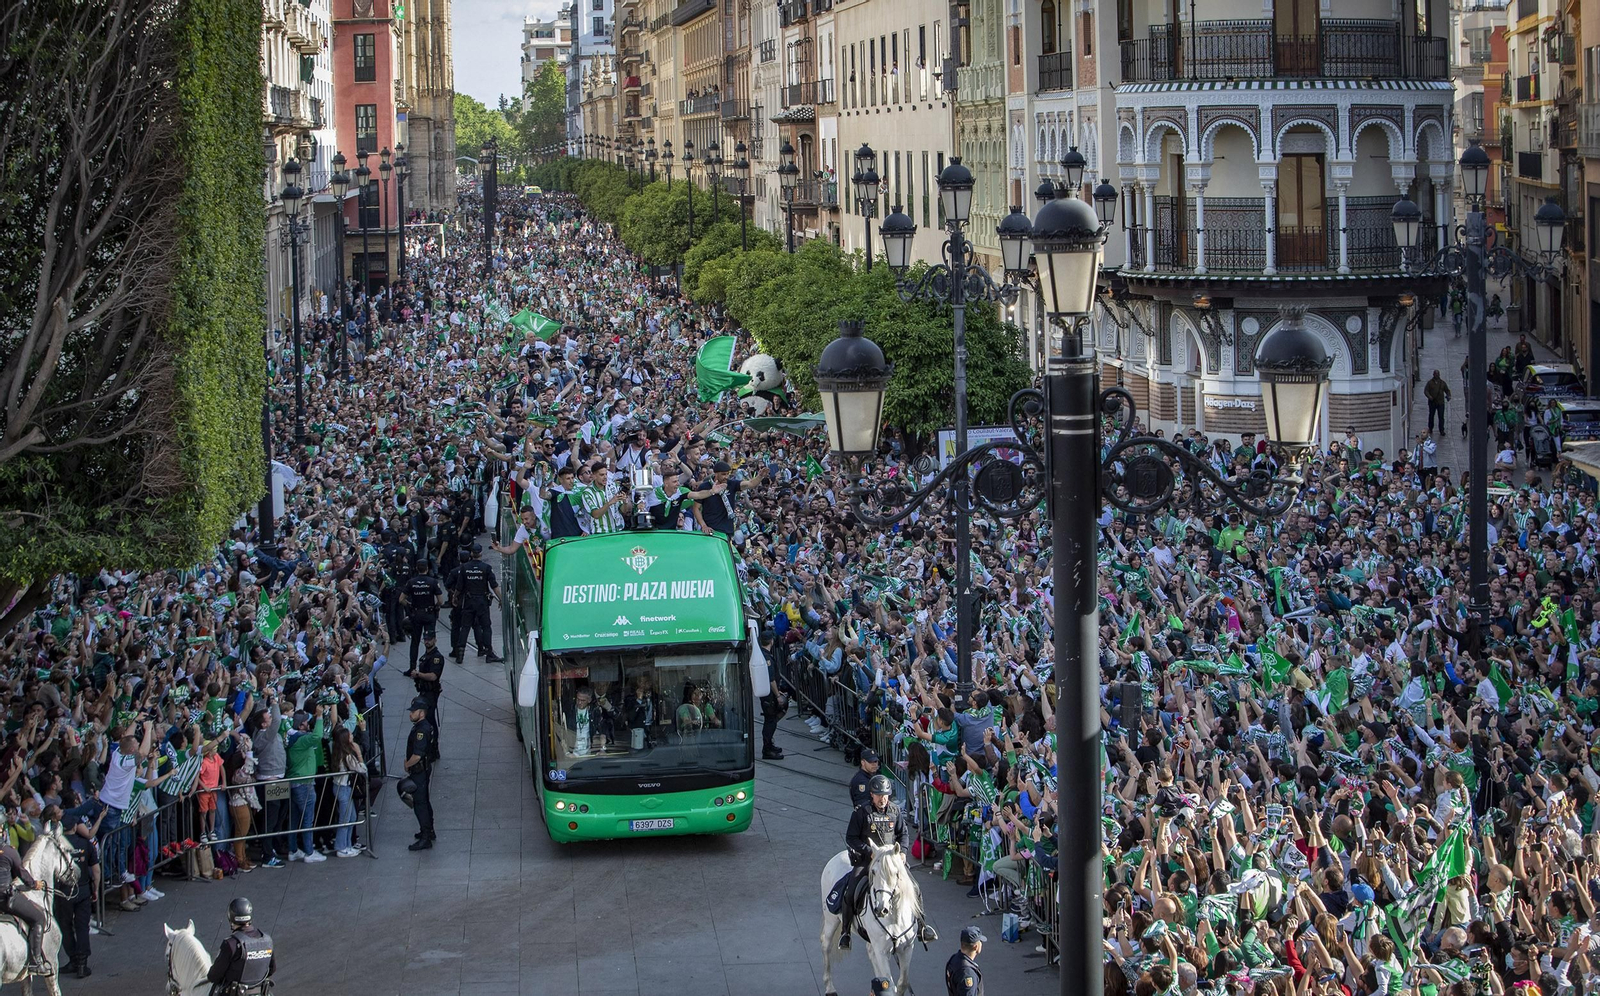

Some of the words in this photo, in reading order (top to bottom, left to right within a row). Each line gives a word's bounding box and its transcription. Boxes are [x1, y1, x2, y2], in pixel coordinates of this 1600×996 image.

[562, 583, 621, 604] DESTINO:
[623, 581, 667, 601] PLAZA
[670, 579, 715, 600] NUEVA
[640, 614, 677, 622] finetwork
[635, 821, 654, 829] 6397
[657, 820, 672, 828] DZS
